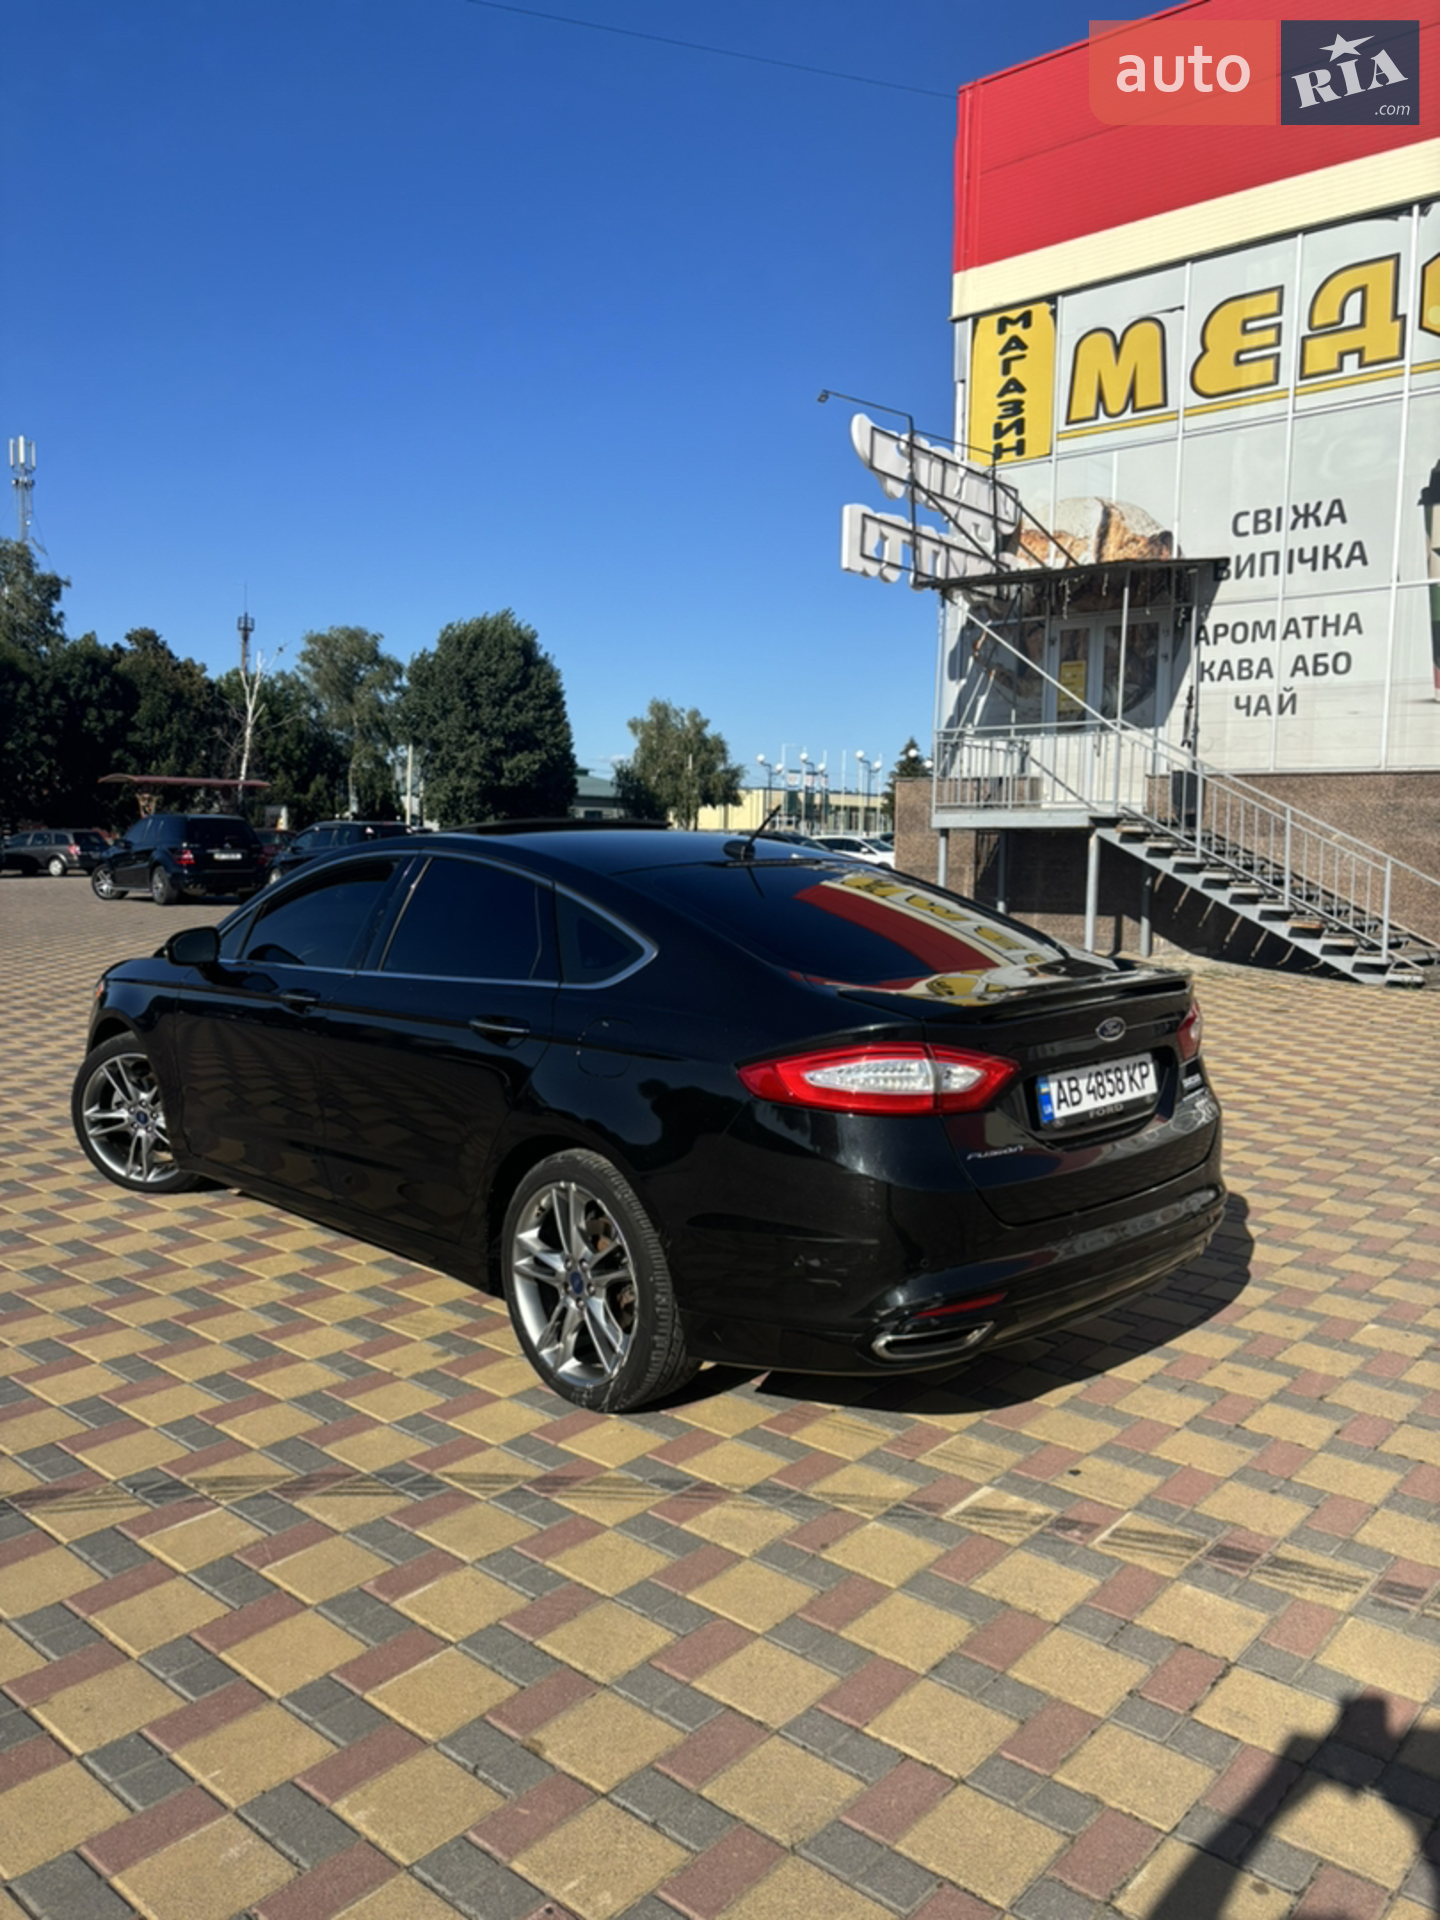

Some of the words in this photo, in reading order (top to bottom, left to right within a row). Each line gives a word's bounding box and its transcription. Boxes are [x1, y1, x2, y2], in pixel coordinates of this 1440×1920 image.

[993, 309, 1033, 462] МАГАЗИН
[1231, 498, 1348, 538] СВІЖА
[1212, 539, 1369, 582] ВИПІЧКА
[1195, 611, 1364, 647] АРОМАТНА
[1199, 656, 1274, 683] КАВА
[1289, 651, 1353, 678] АБО
[1234, 686, 1298, 718] ЧАЙ
[1056, 1076, 1083, 1110] AB
[1086, 1066, 1126, 1101] 4858
[1126, 1060, 1150, 1092] KP
